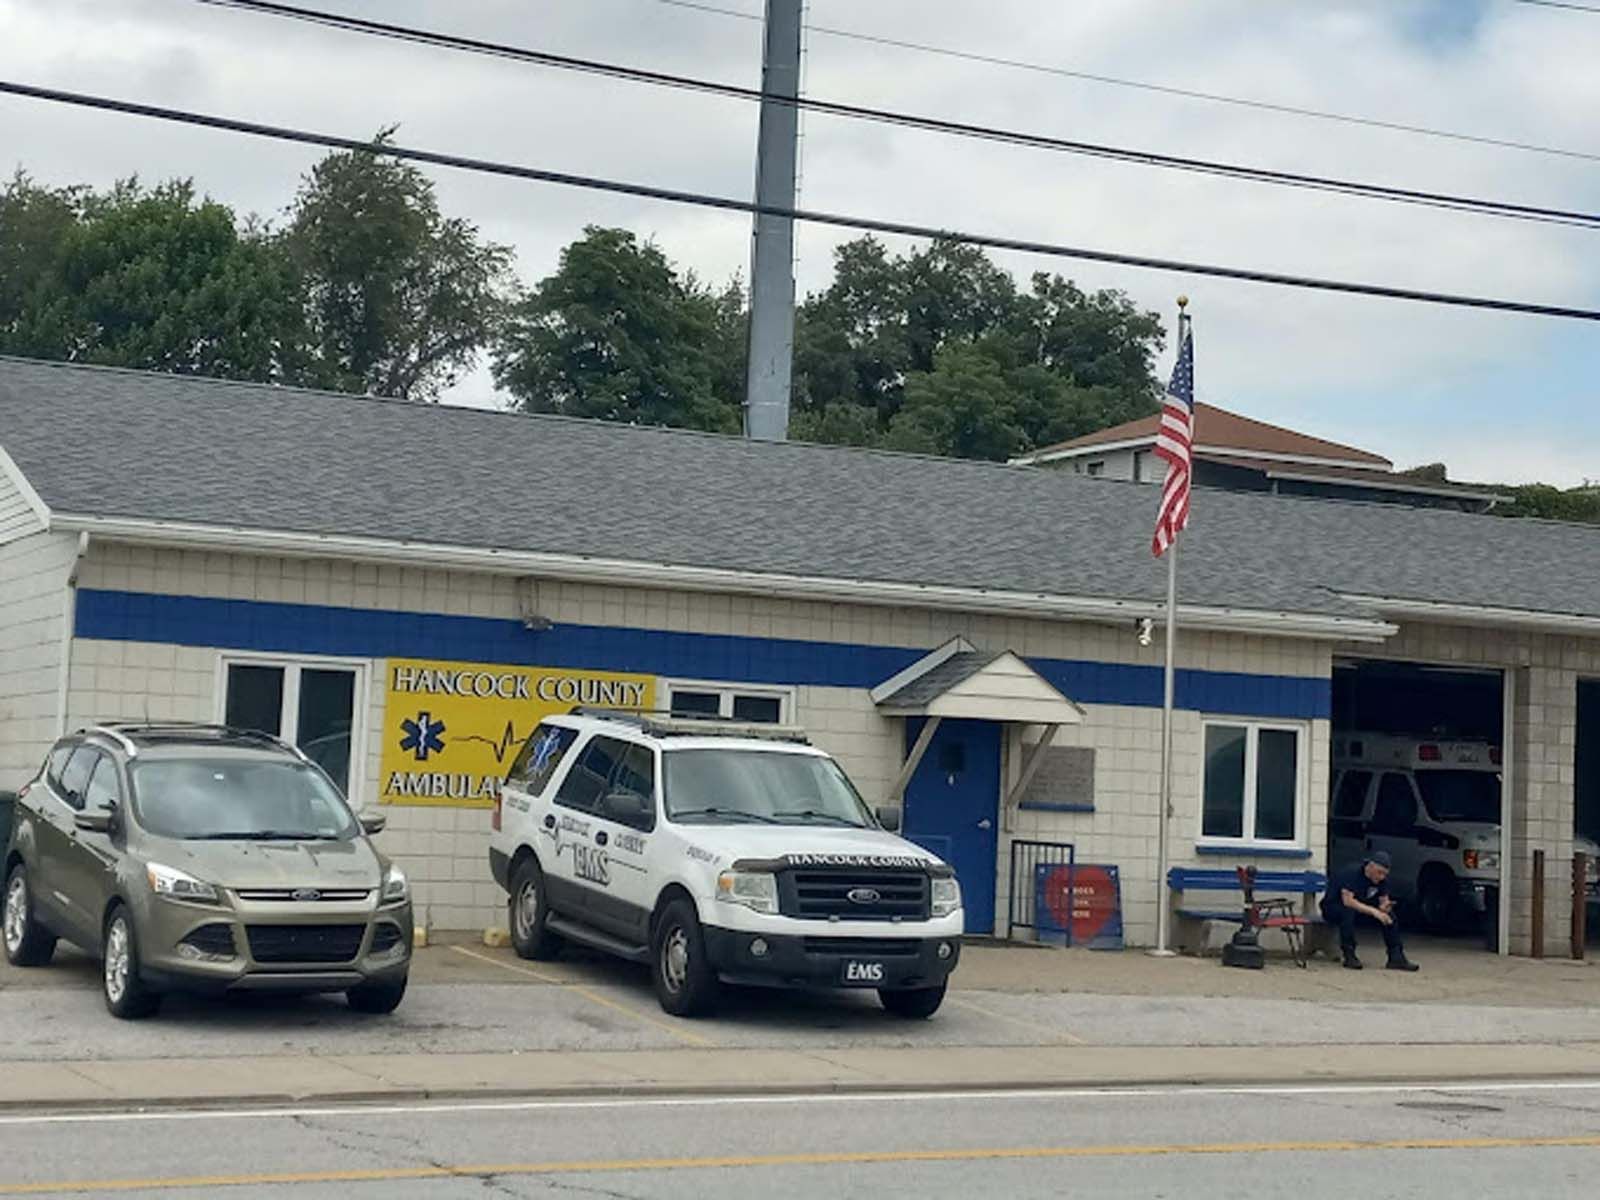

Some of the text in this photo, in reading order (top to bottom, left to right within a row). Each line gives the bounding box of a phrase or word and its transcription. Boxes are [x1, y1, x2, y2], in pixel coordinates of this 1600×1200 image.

[393, 666, 646, 706] HANCOCK COUNTY
[847, 962, 883, 981] EMS
